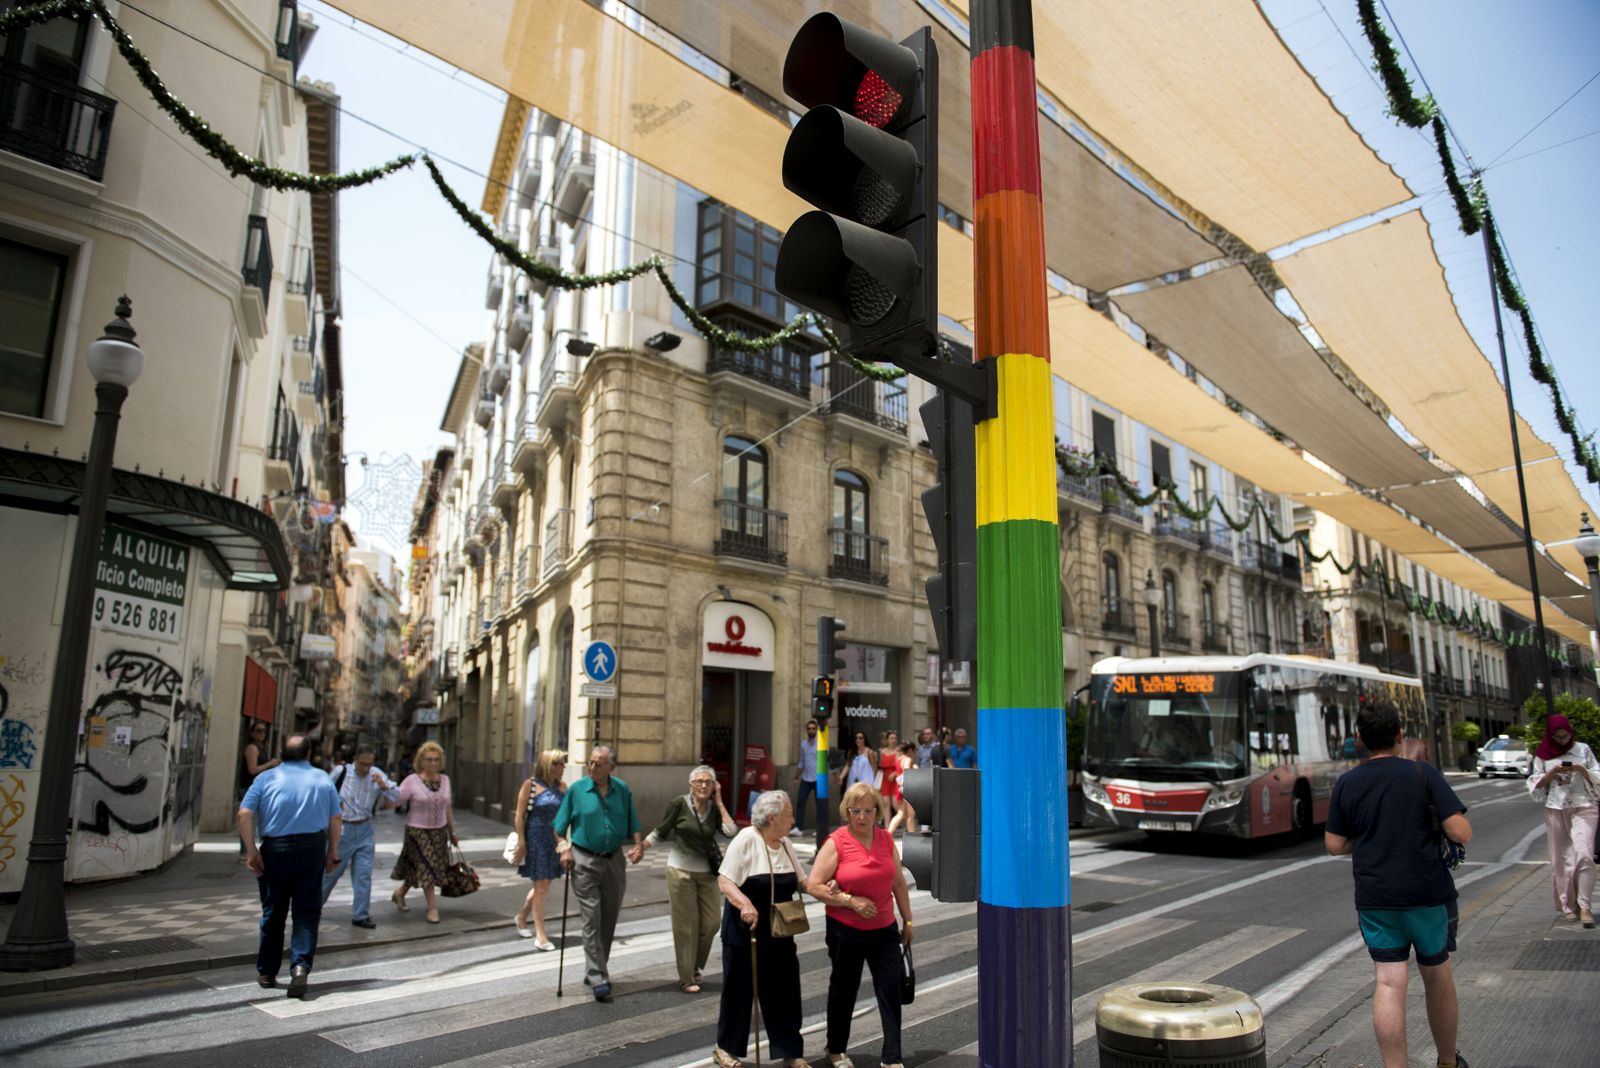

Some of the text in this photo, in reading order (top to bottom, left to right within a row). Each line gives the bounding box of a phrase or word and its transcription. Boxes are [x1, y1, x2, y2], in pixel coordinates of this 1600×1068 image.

[112, 532, 185, 573] ALQUILA
[128, 568, 184, 599] Completo
[111, 600, 142, 628] 526
[149, 607, 176, 634] 881
[844, 705, 887, 718] vodafone
[1116, 792, 1131, 806] 36
